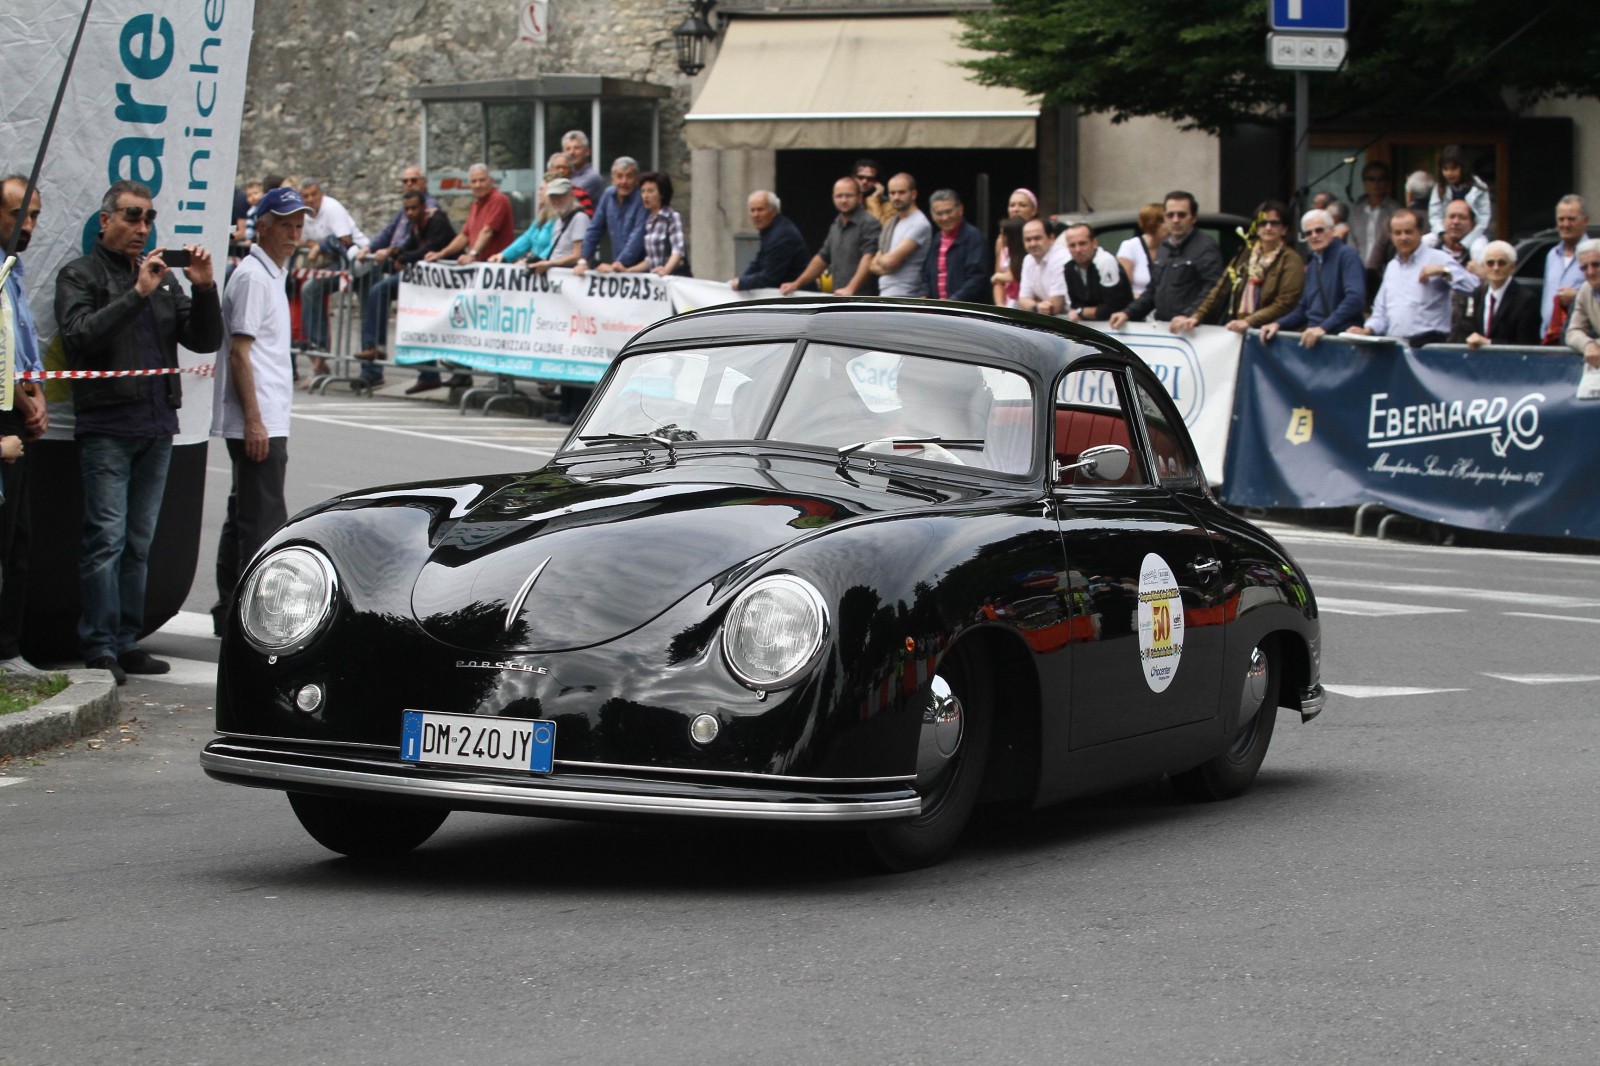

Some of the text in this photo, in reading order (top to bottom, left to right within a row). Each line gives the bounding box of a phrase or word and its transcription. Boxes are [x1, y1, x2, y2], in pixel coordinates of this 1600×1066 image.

[174, 0, 225, 237] liniche
[587, 275, 651, 300] ECOGAS
[464, 294, 536, 335] Vaillant
[536, 316, 568, 332] Service
[570, 311, 597, 336] plus
[1295, 415, 1308, 436] E
[1368, 393, 1508, 439] EBERHARD
[1153, 605, 1170, 642] 50
[455, 660, 549, 675] PORSCHE
